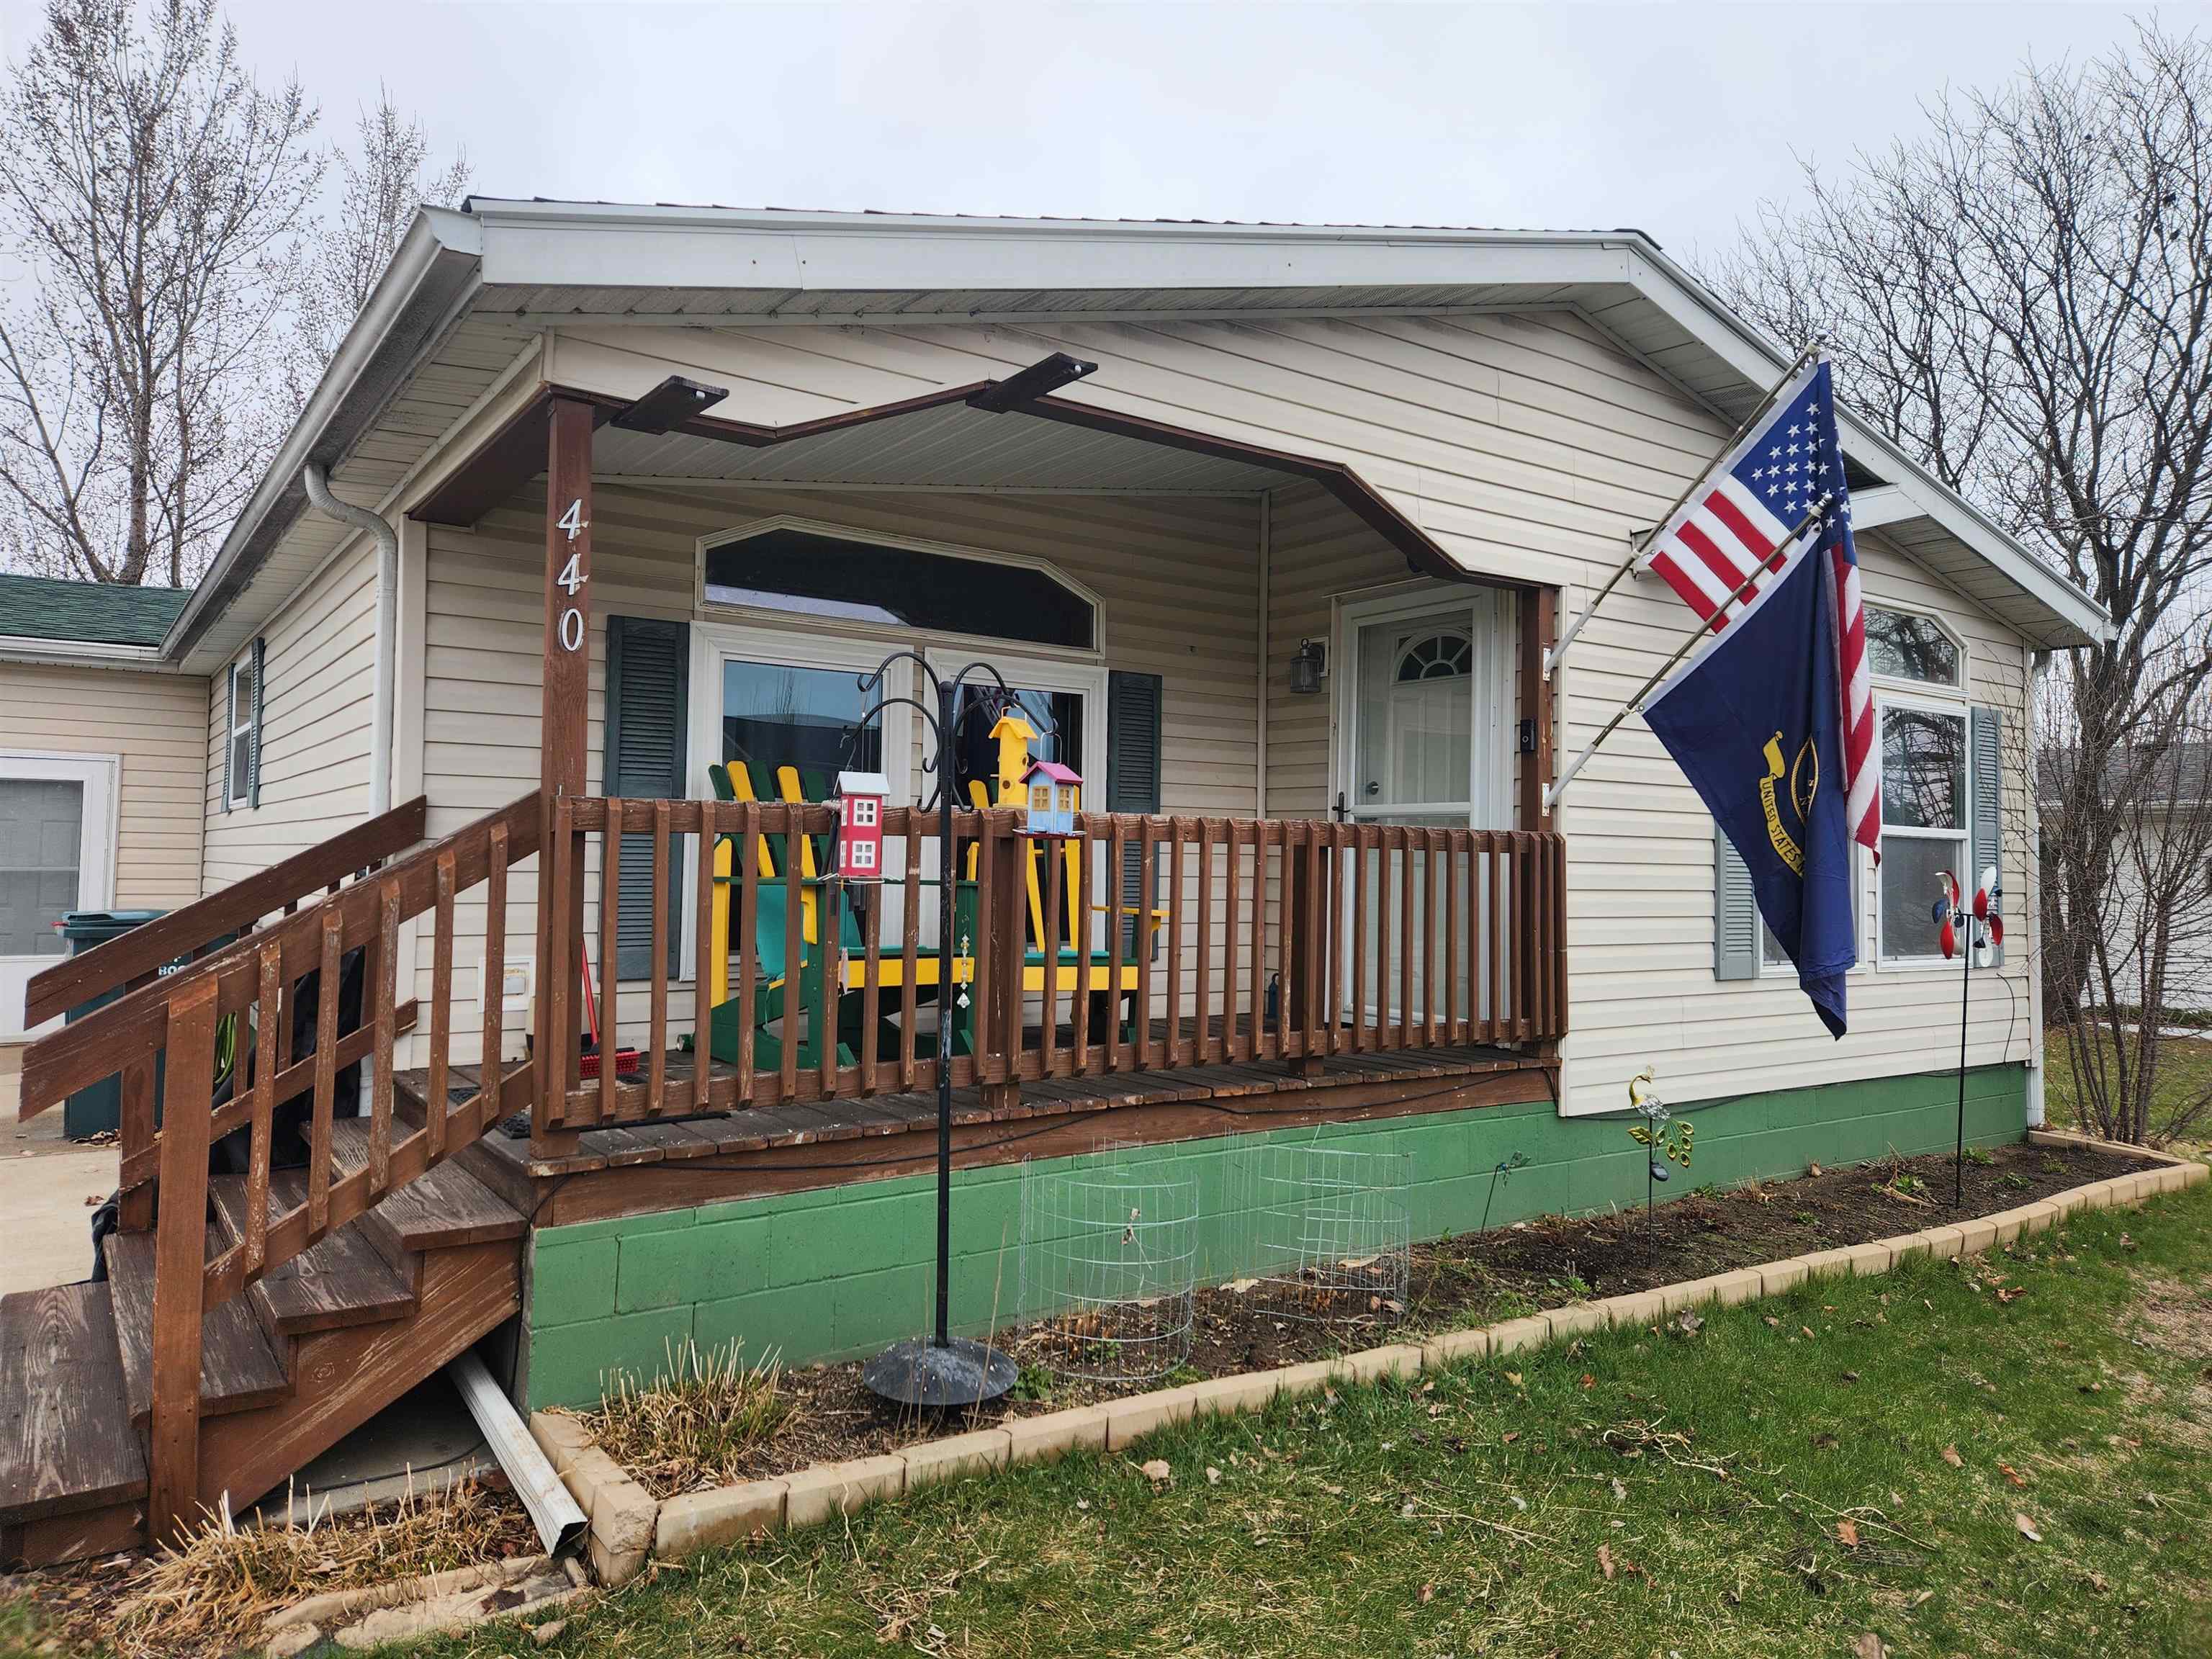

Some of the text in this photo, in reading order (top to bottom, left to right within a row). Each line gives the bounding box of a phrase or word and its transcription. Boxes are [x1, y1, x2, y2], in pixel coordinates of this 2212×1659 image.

[556, 498, 588, 652] 440
[1762, 781, 1801, 862] UNITED STATES
